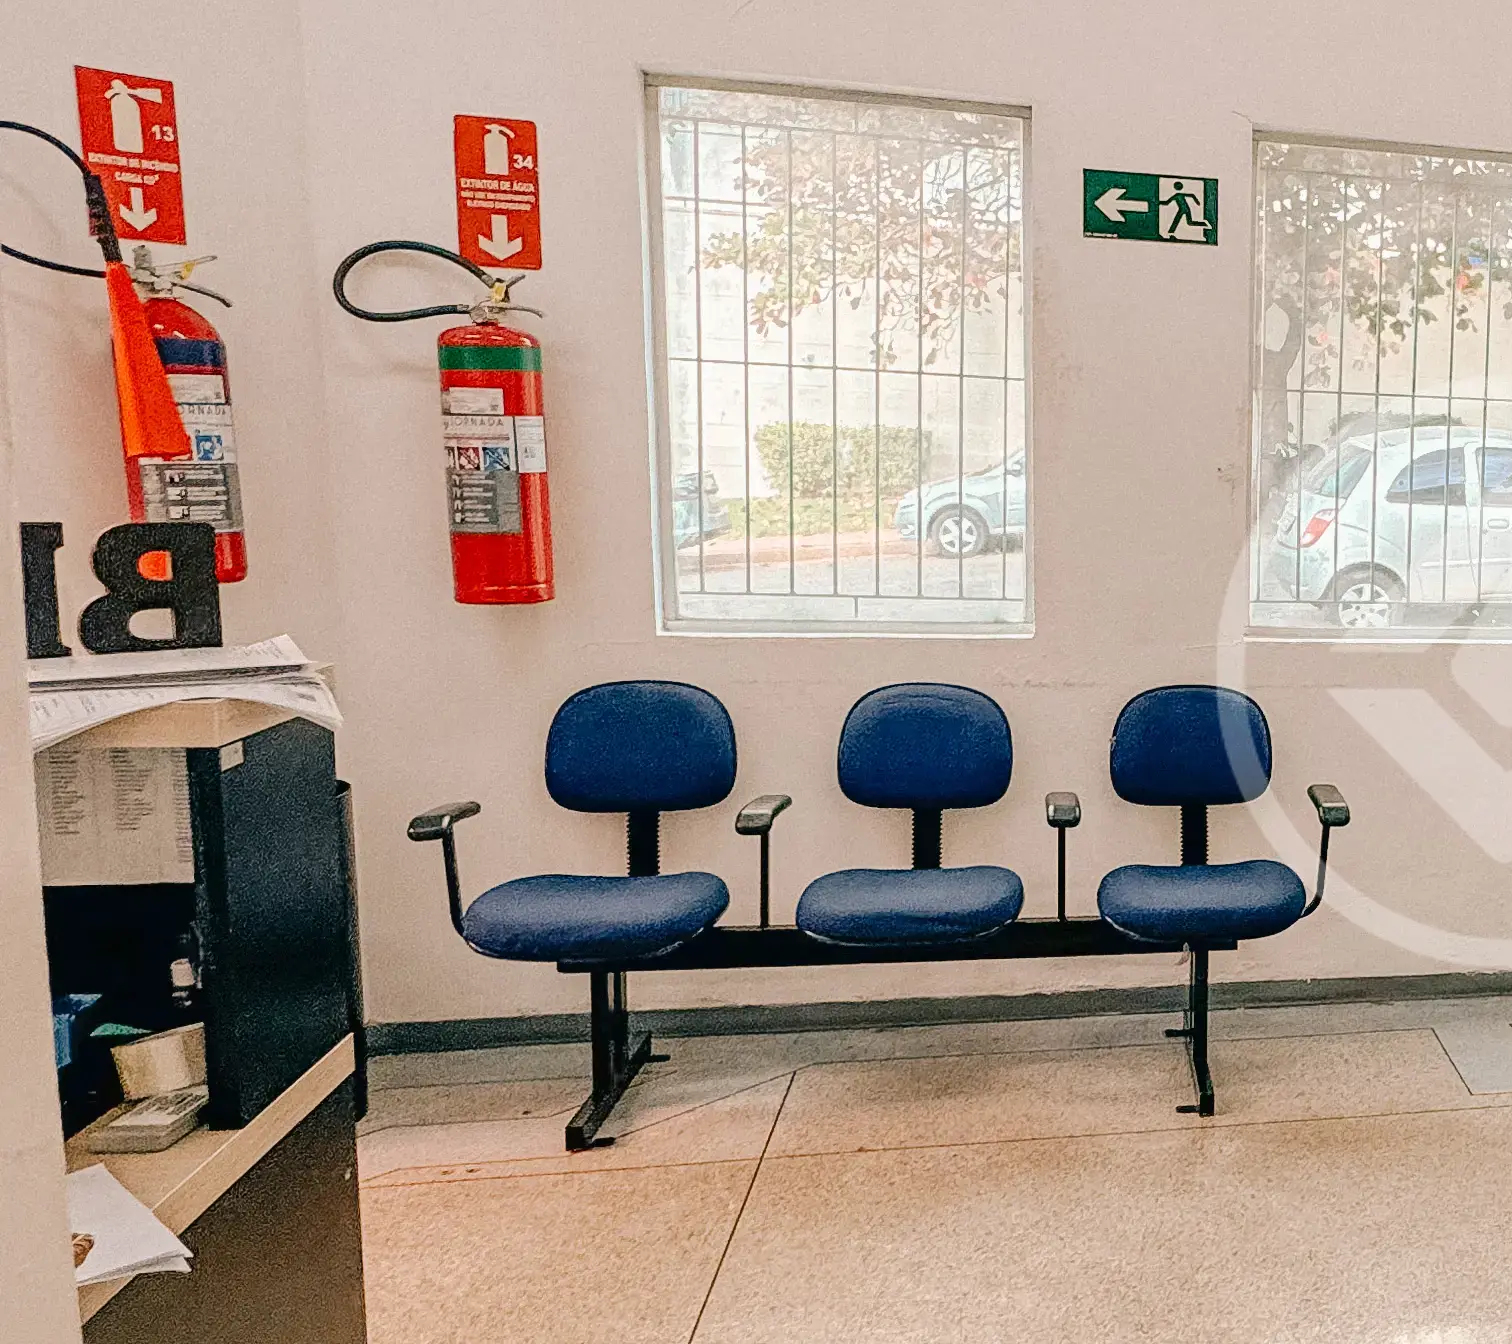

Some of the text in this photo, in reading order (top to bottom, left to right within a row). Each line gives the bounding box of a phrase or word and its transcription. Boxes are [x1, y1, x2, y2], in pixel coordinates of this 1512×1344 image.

[152, 125, 175, 142] 13
[512, 154, 534, 170] 34
[177, 405, 226, 416] ORNADA
